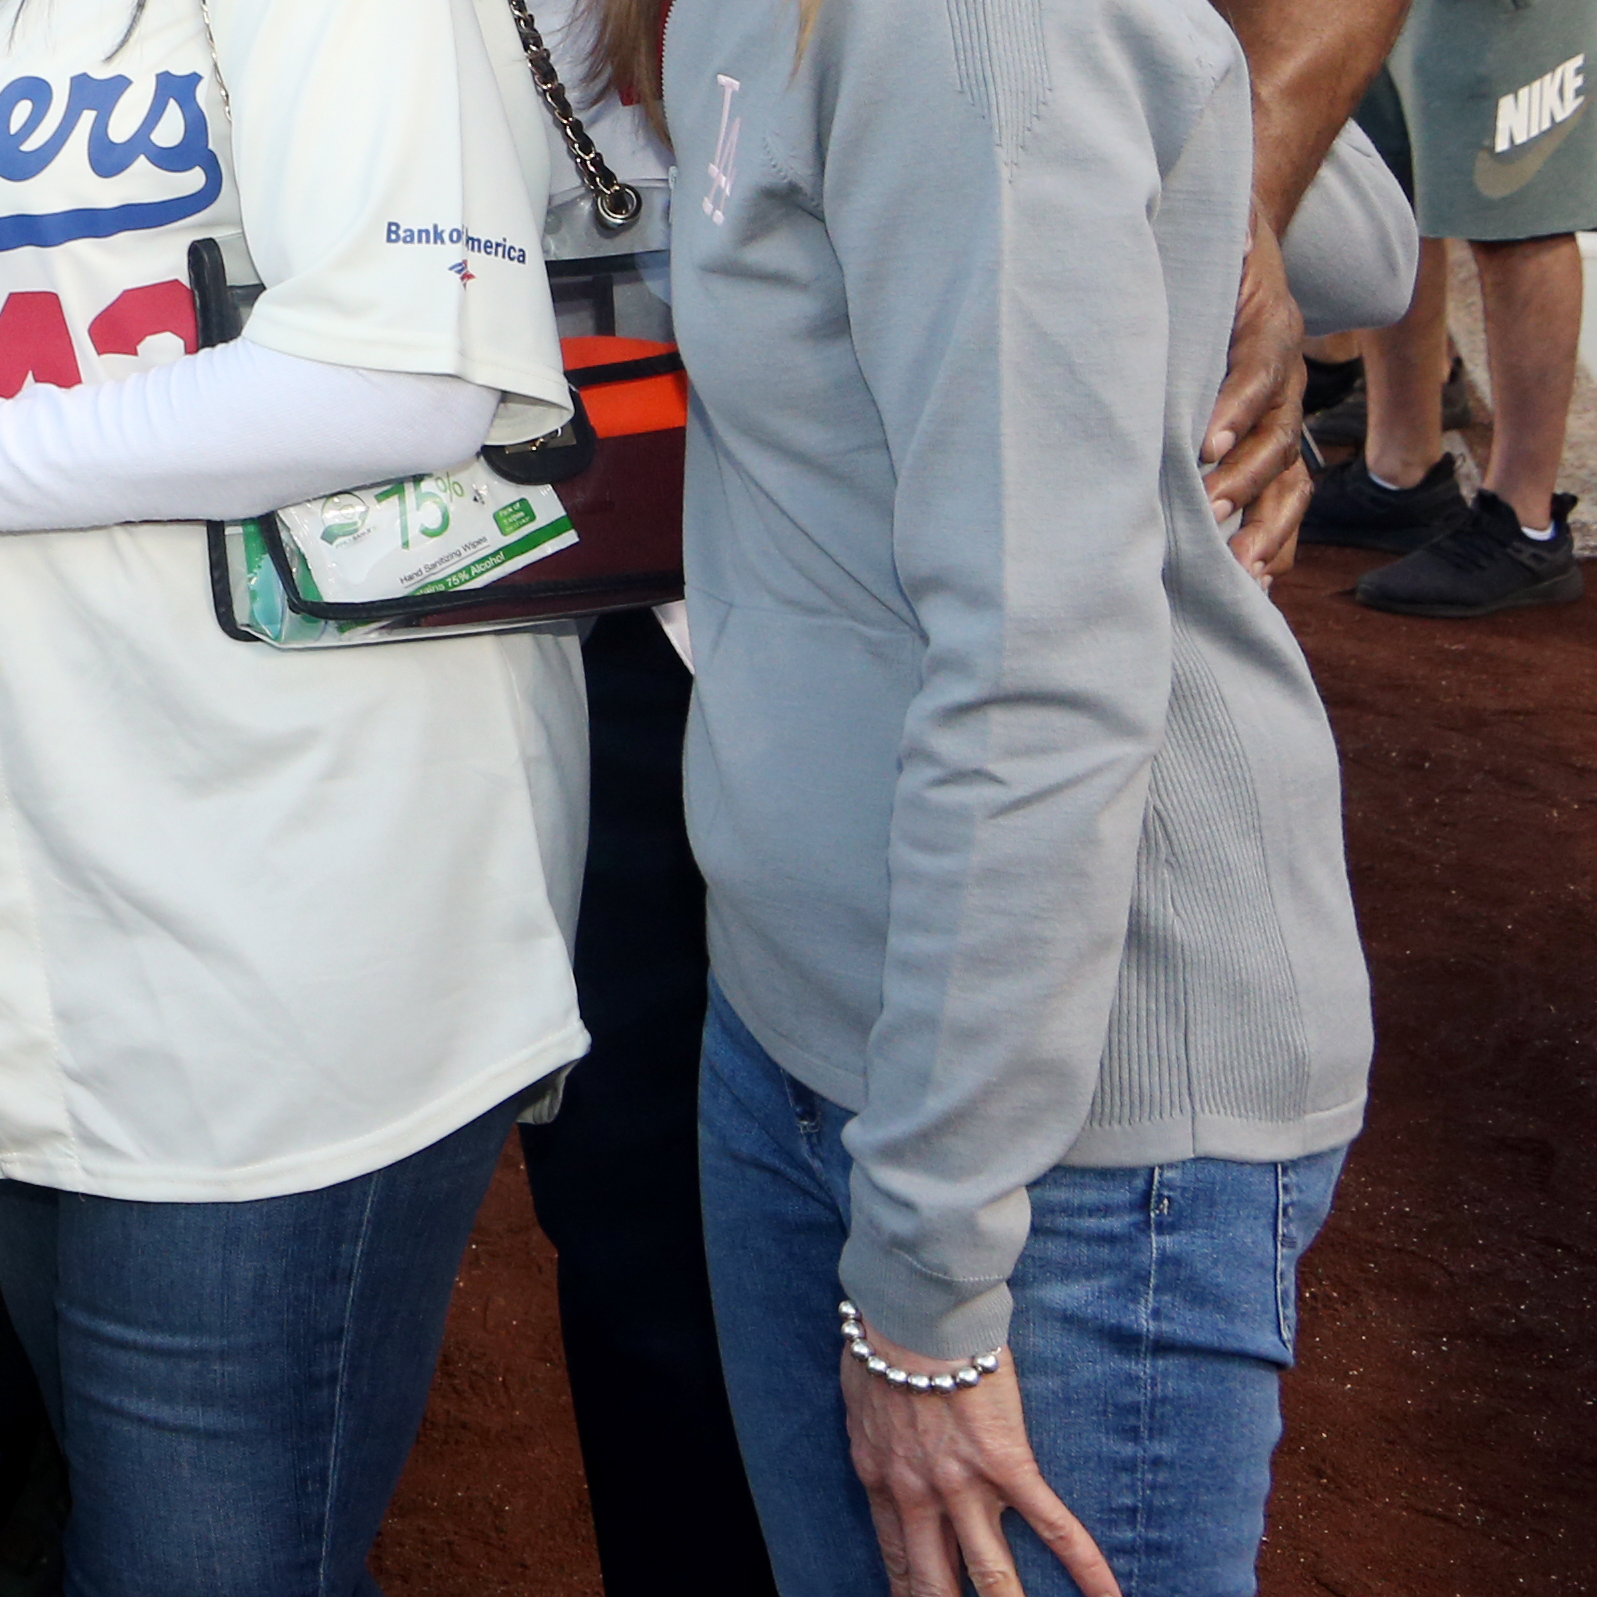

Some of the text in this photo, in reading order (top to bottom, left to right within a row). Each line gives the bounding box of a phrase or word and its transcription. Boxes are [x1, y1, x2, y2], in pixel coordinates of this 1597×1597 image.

[1494, 53, 1585, 154] NIKE
[385, 220, 446, 245] Bank
[464, 226, 527, 265] merica
[399, 536, 488, 585] Hand Sanitizing Wipes
[446, 570, 470, 588] 75%
[470, 550, 506, 577] Alcohol
